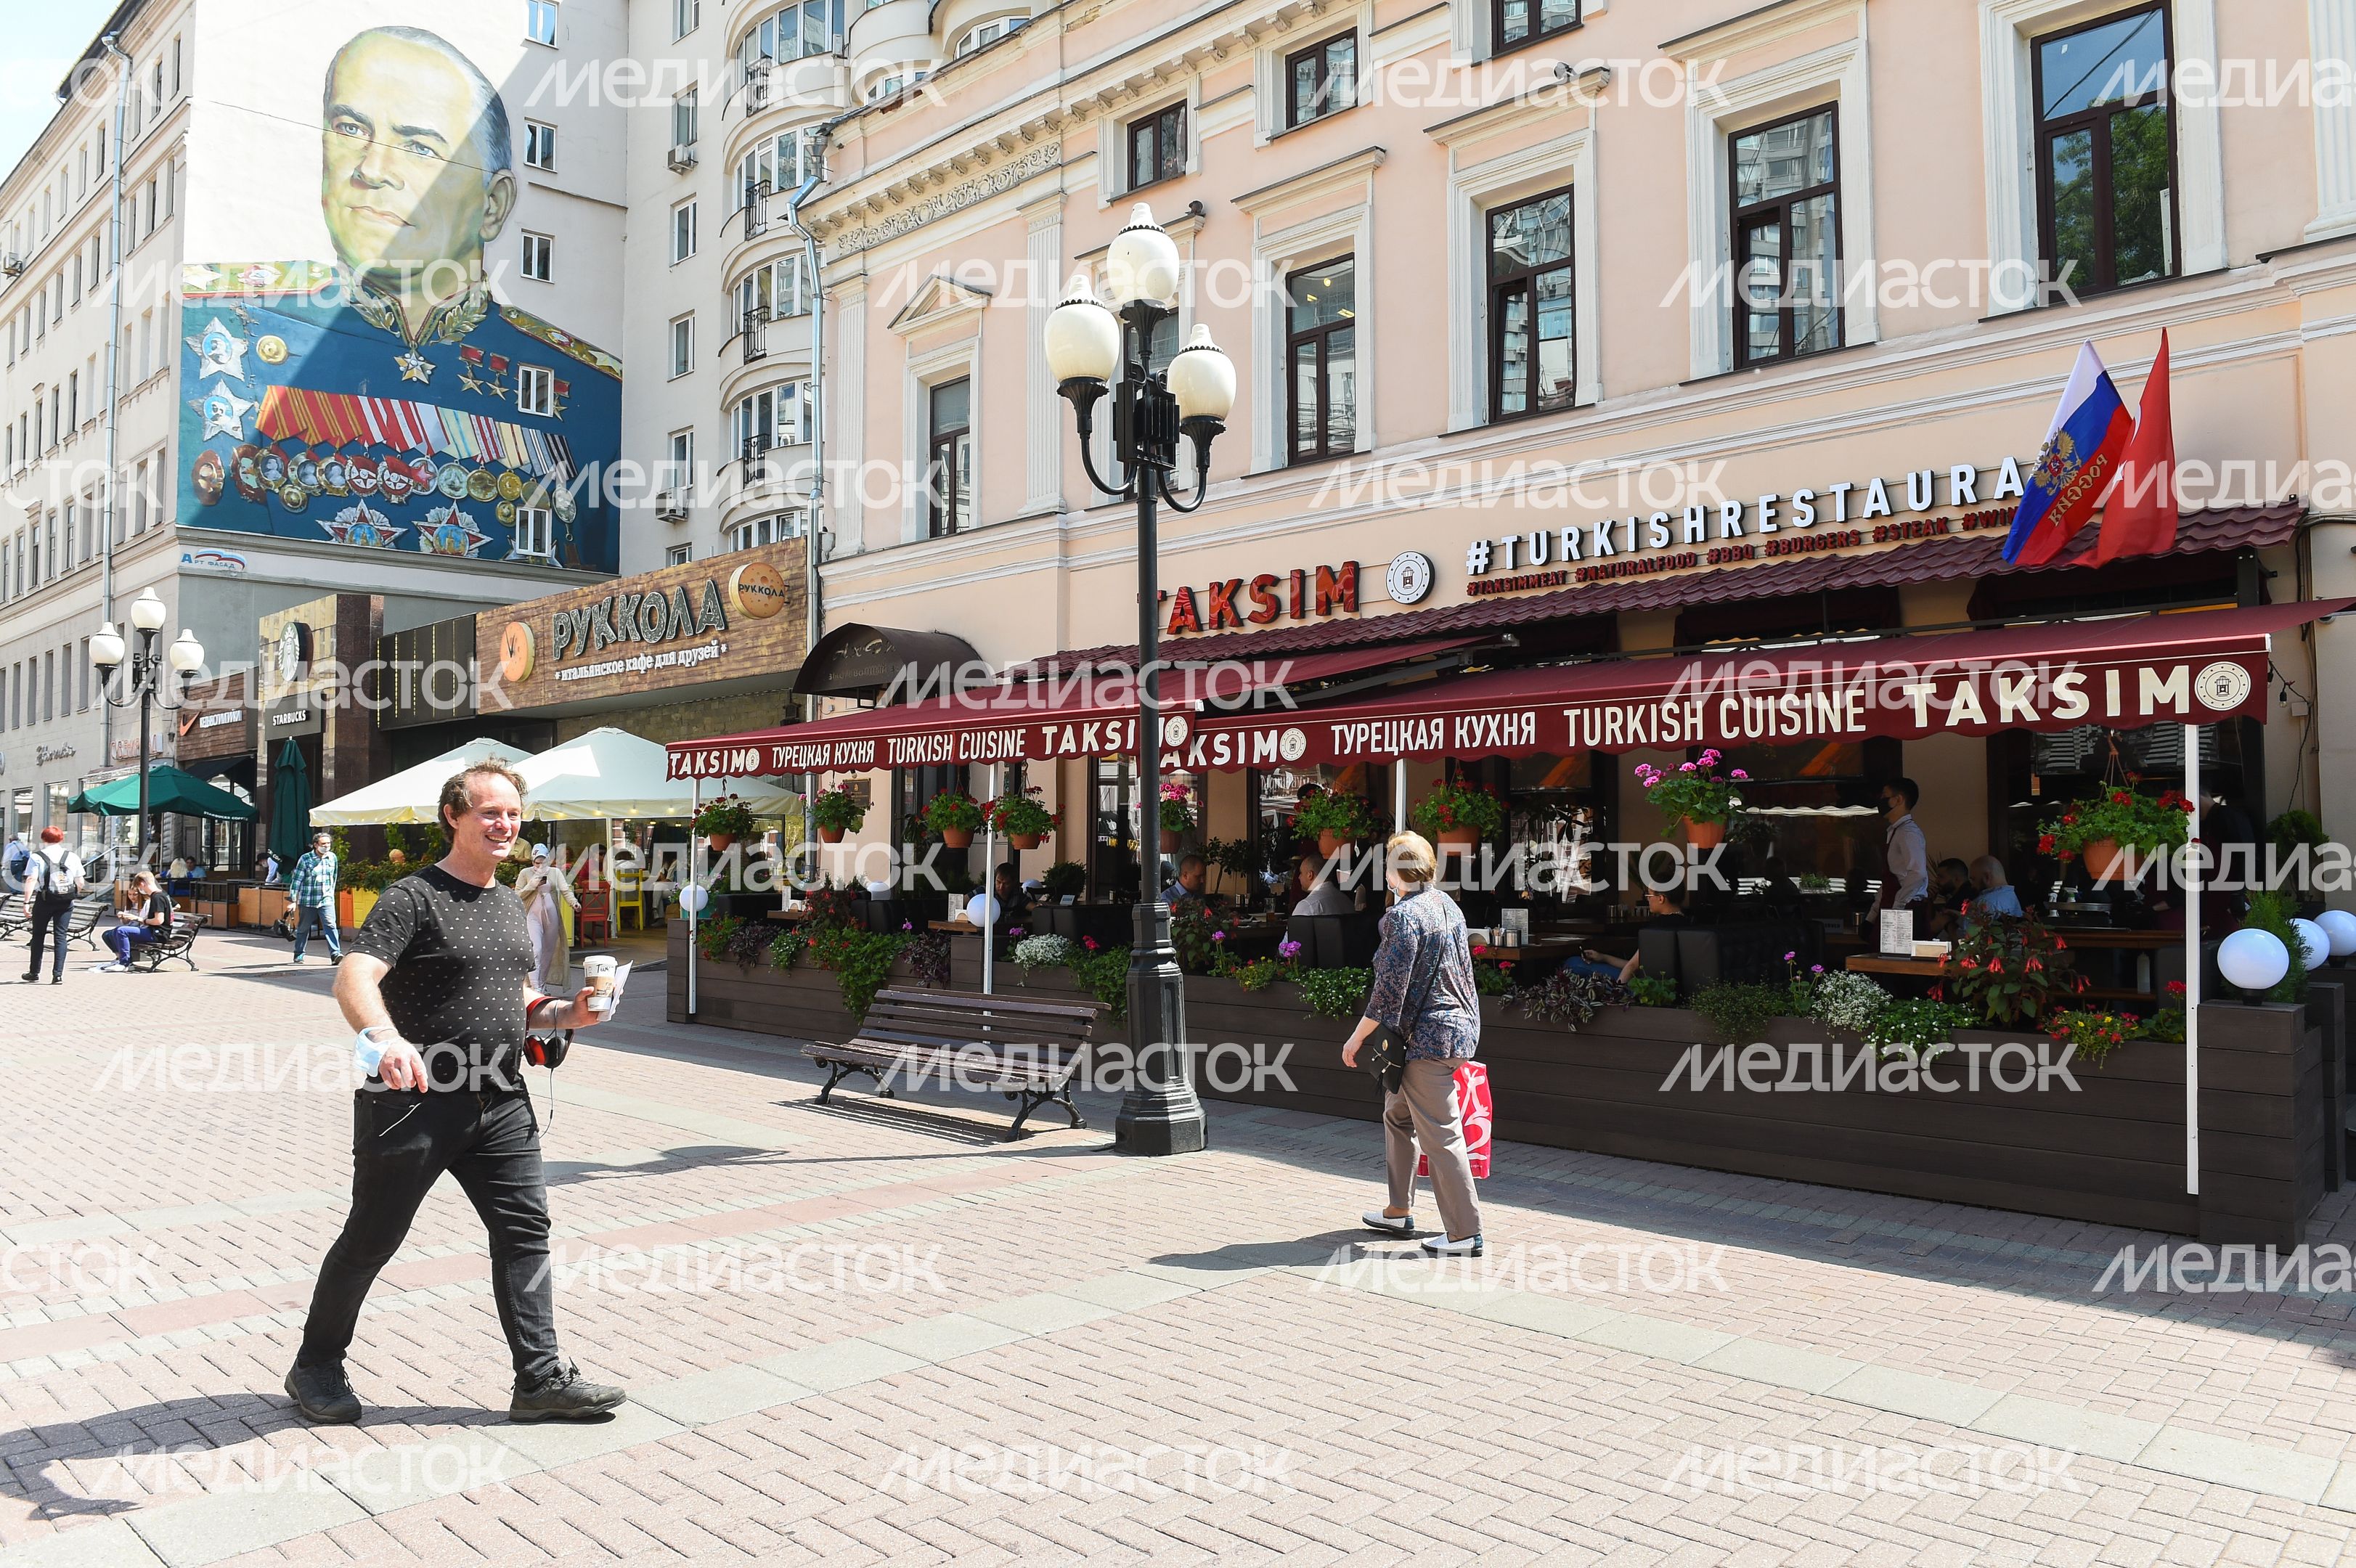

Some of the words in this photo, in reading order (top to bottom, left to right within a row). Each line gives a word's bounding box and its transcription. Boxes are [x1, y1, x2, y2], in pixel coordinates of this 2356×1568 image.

[207, 560, 236, 569] ФАСАД
[1466, 570, 1568, 596] #TAKSIMMEAT
[1574, 551, 1698, 583] #NATURALFOOD
[1706, 544, 1754, 565] #BBQ
[1764, 529, 1861, 558] #BURGERS
[1872, 516, 1950, 544] #STEAK
[738, 583, 786, 599] РУККОЛА
[1156, 560, 1360, 635] AKSIM
[552, 579, 727, 661] РУККОЛА
[561, 658, 626, 682] итальянское
[625, 653, 654, 674] кафе
[654, 652, 677, 670] для
[677, 640, 720, 668] друзей
[1902, 664, 2190, 729] TAKSIM
[272, 709, 307, 727] STARBUCKS
[1041, 719, 1164, 756] TAKSI
[1331, 716, 1444, 757] ТУРЕЦКАЯ
[1454, 711, 1536, 749] КУХНЯ
[1563, 700, 1704, 748] TURKISH
[1719, 689, 1867, 740] CUISINE
[669, 748, 746, 777] TAKSIM
[771, 743, 831, 770] ТУРЕЦКАЯ
[833, 739, 876, 764] КУХНЯ
[887, 731, 953, 765] TURKISH
[959, 727, 1027, 759] CUISINE
[1159, 730, 1279, 769] AKSIM
